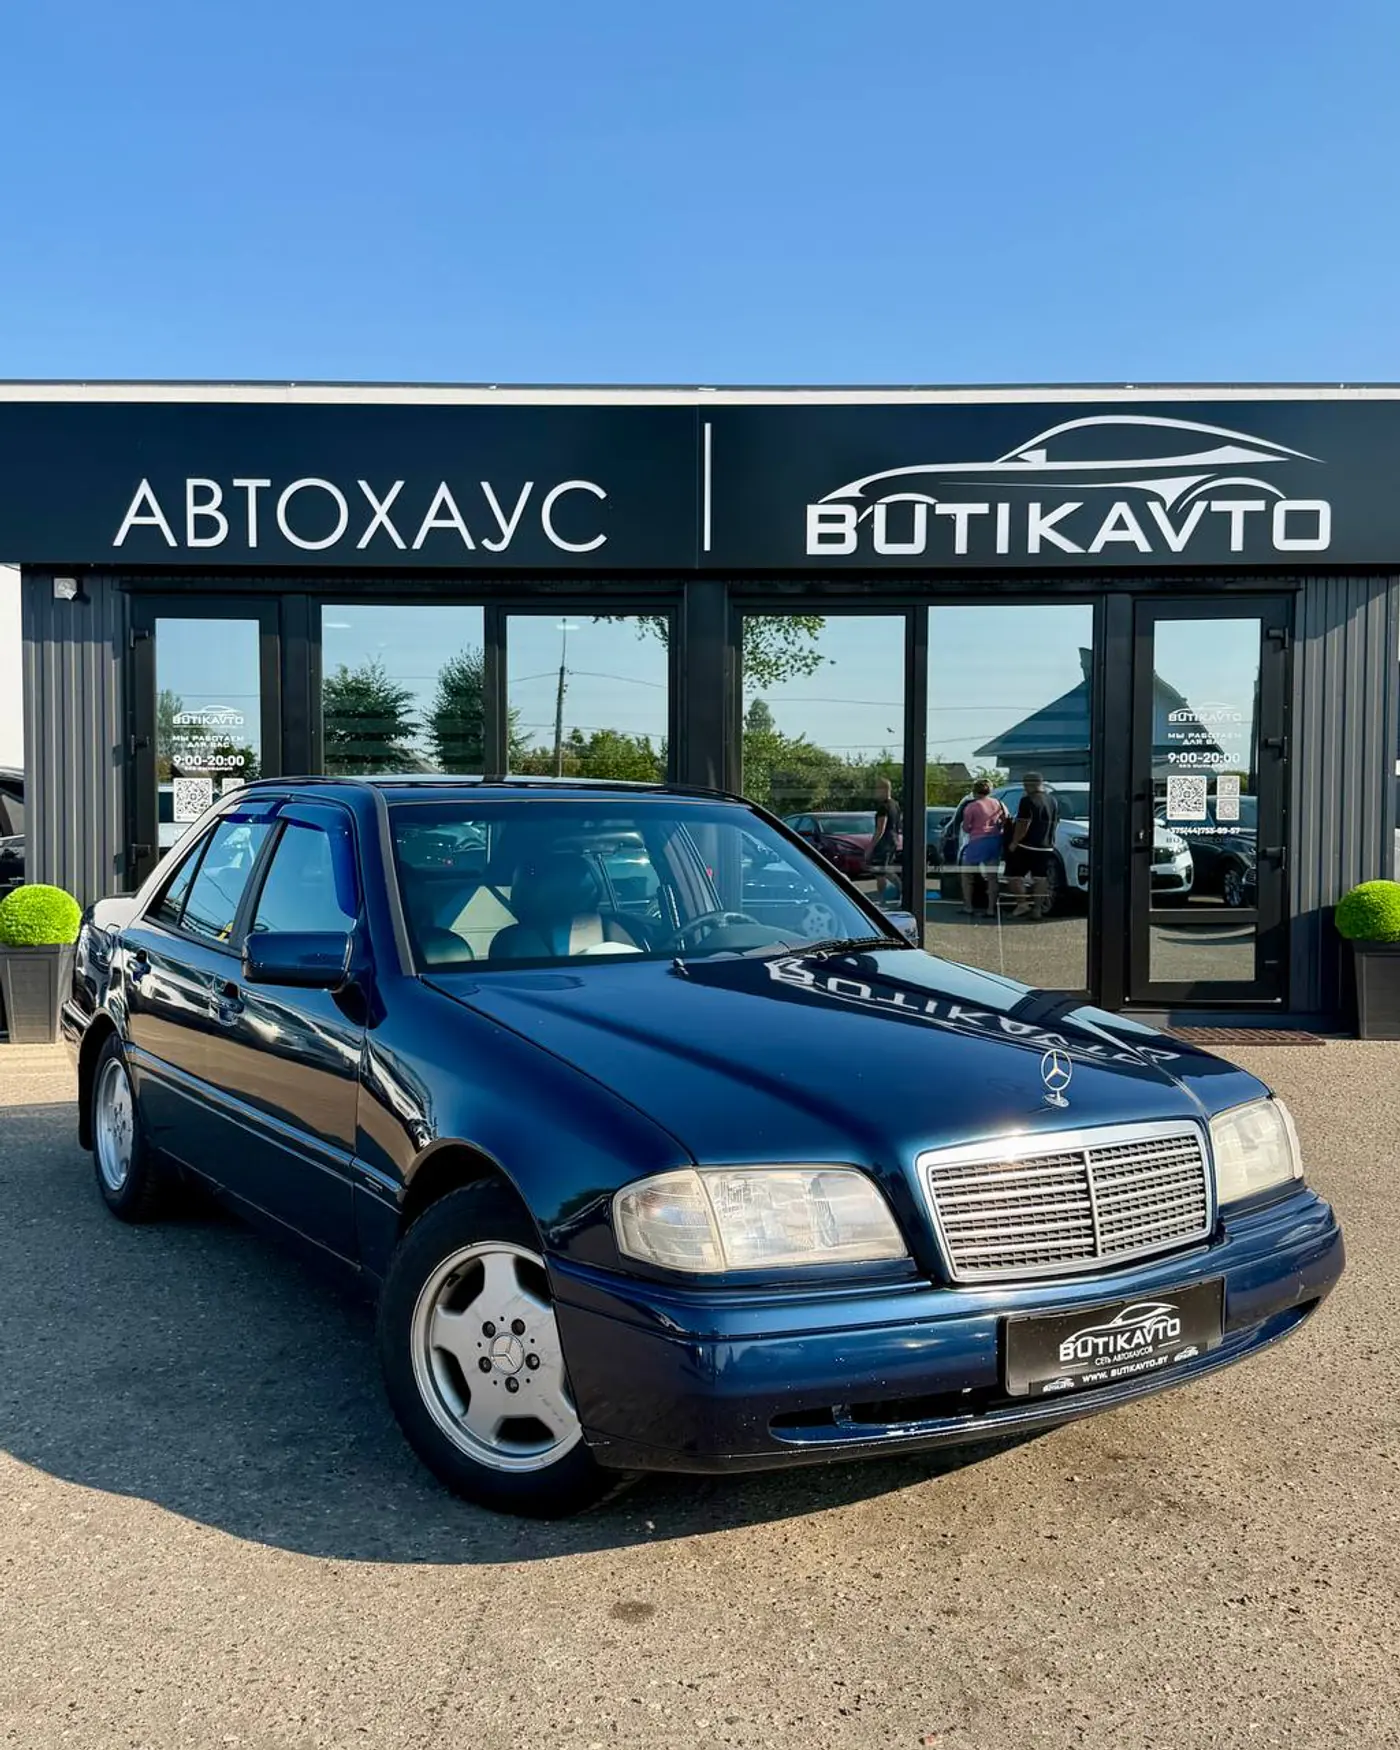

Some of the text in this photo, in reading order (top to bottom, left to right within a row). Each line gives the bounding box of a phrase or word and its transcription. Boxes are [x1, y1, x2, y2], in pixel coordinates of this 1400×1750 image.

[113, 478, 608, 553] АВТОХАУС
[805, 499, 1332, 555] BUTIKAVTO
[172, 715, 244, 725] BUTIKAVTO
[172, 755, 245, 767] 9:00-20:00
[1167, 752, 1241, 763] 9:00-20:00
[1059, 1317, 1181, 1362] BUTIKAVTO
